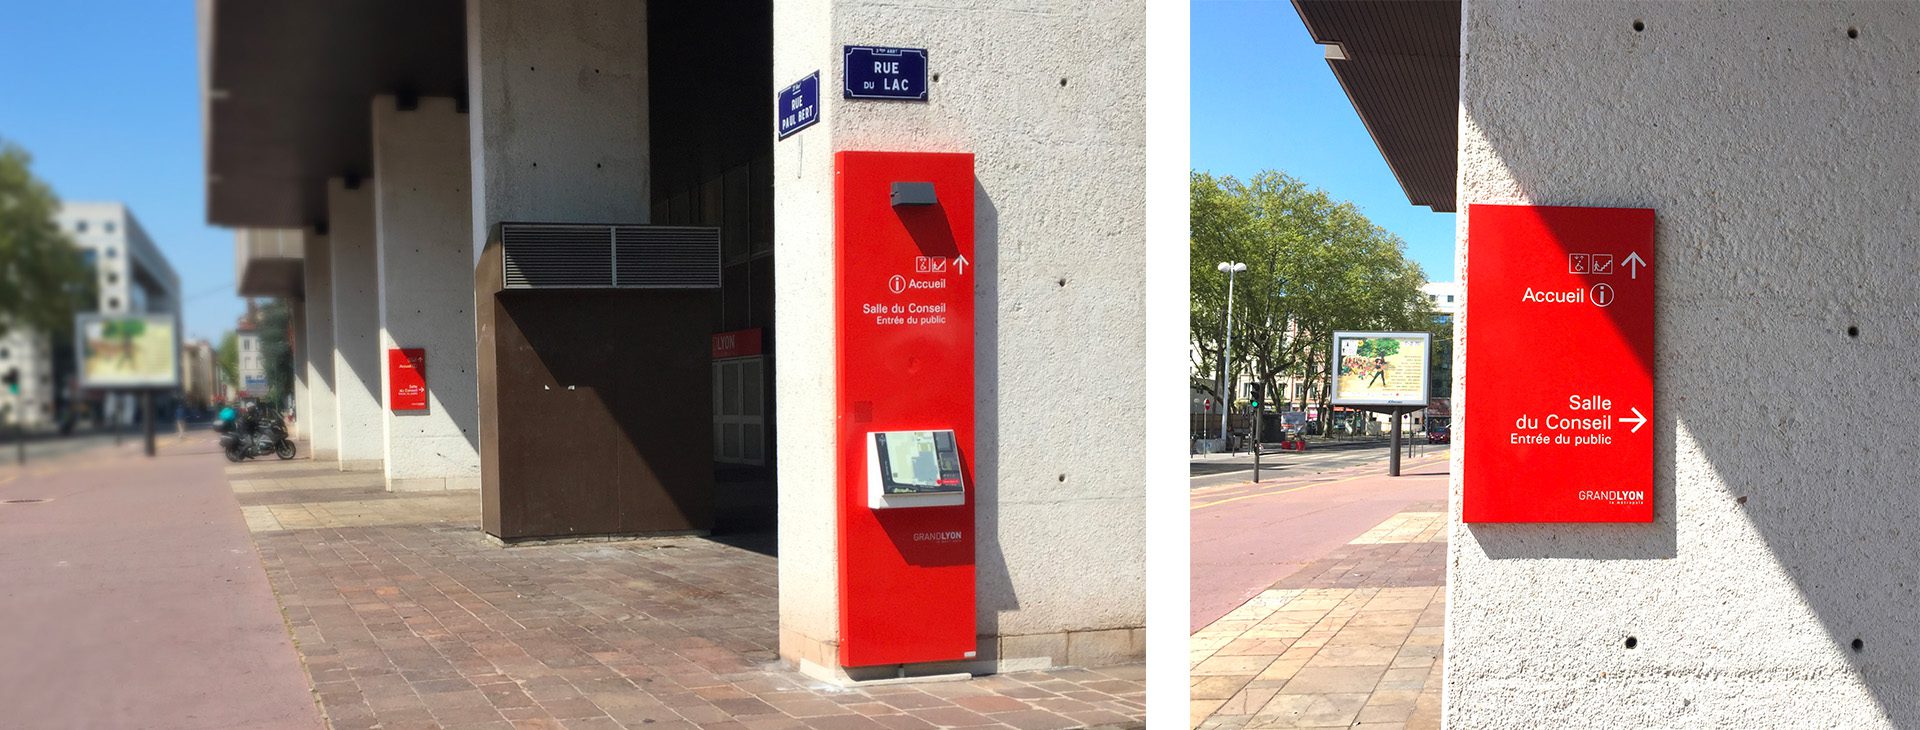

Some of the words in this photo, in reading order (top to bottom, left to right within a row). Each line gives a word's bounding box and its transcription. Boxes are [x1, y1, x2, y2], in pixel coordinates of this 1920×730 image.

[874, 61, 900, 74] RUE
[863, 81, 875, 89] DU
[884, 78, 909, 91] LAC
[791, 95, 803, 111] RUE
[782, 114, 797, 130] PAUL
[798, 104, 813, 122] BERT
[908, 279, 946, 289] Accueil
[1522, 287, 1584, 303] Accueil
[863, 304, 888, 314] Salle
[891, 304, 904, 313] du
[908, 303, 946, 313] Conseil
[876, 315, 904, 325] Entrée
[907, 316, 918, 324] du
[920, 315, 946, 325] public
[1569, 394, 1612, 410] Salle
[1516, 414, 1538, 430] du
[1546, 414, 1612, 430] Conseil
[1510, 433, 1551, 445] Entrée
[1554, 434, 1570, 444] du
[1574, 434, 1612, 446] public
[1578, 490, 1644, 501] GRANDLYON
